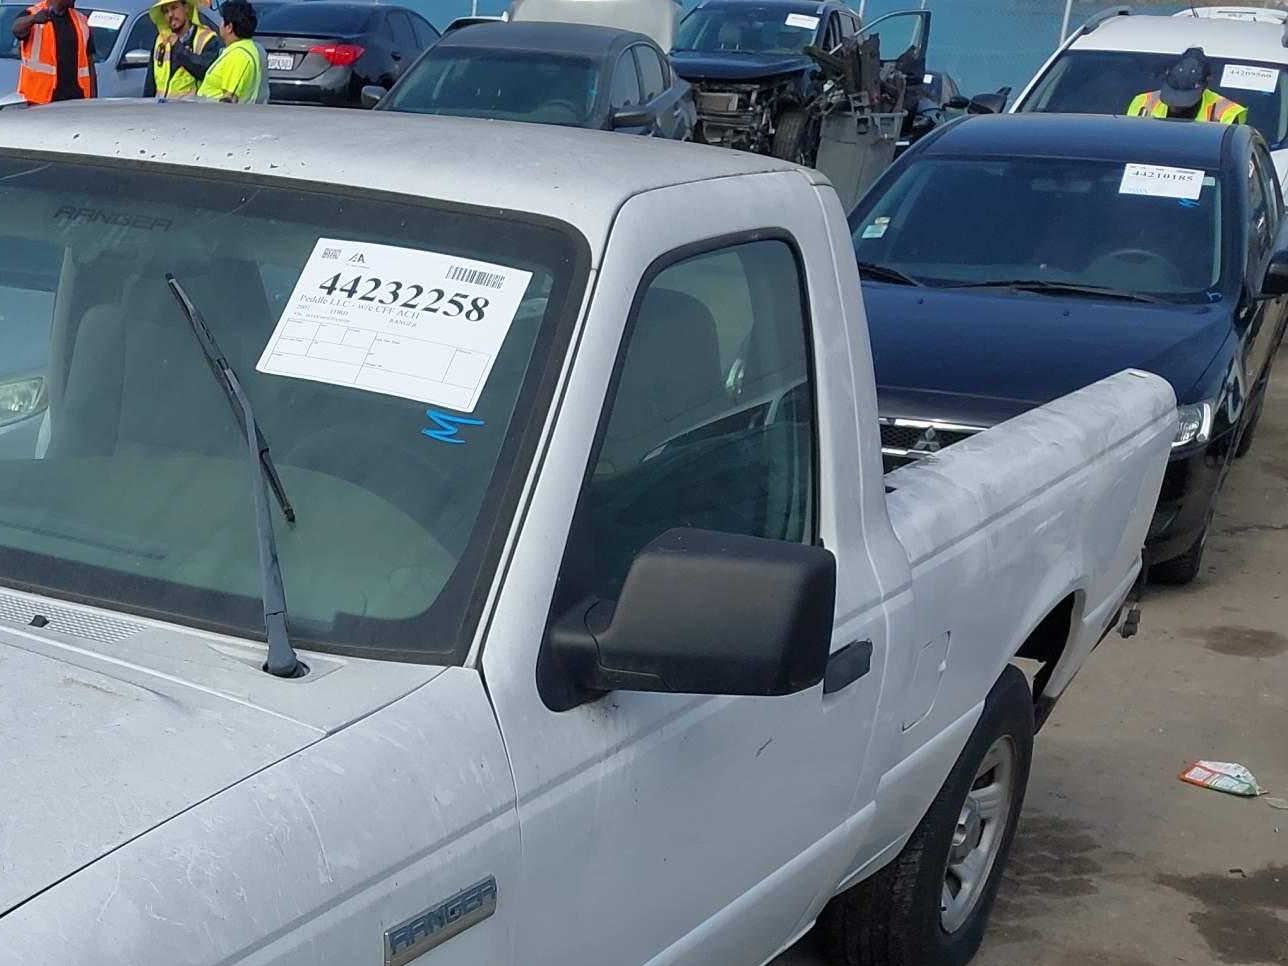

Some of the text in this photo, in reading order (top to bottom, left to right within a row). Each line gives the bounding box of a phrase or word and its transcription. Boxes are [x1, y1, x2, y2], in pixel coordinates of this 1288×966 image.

[52, 205, 174, 232] RANGER
[299, 294, 329, 306] Peddle
[318, 271, 490, 322] 44232258
[391, 884, 496, 956] RANGER
